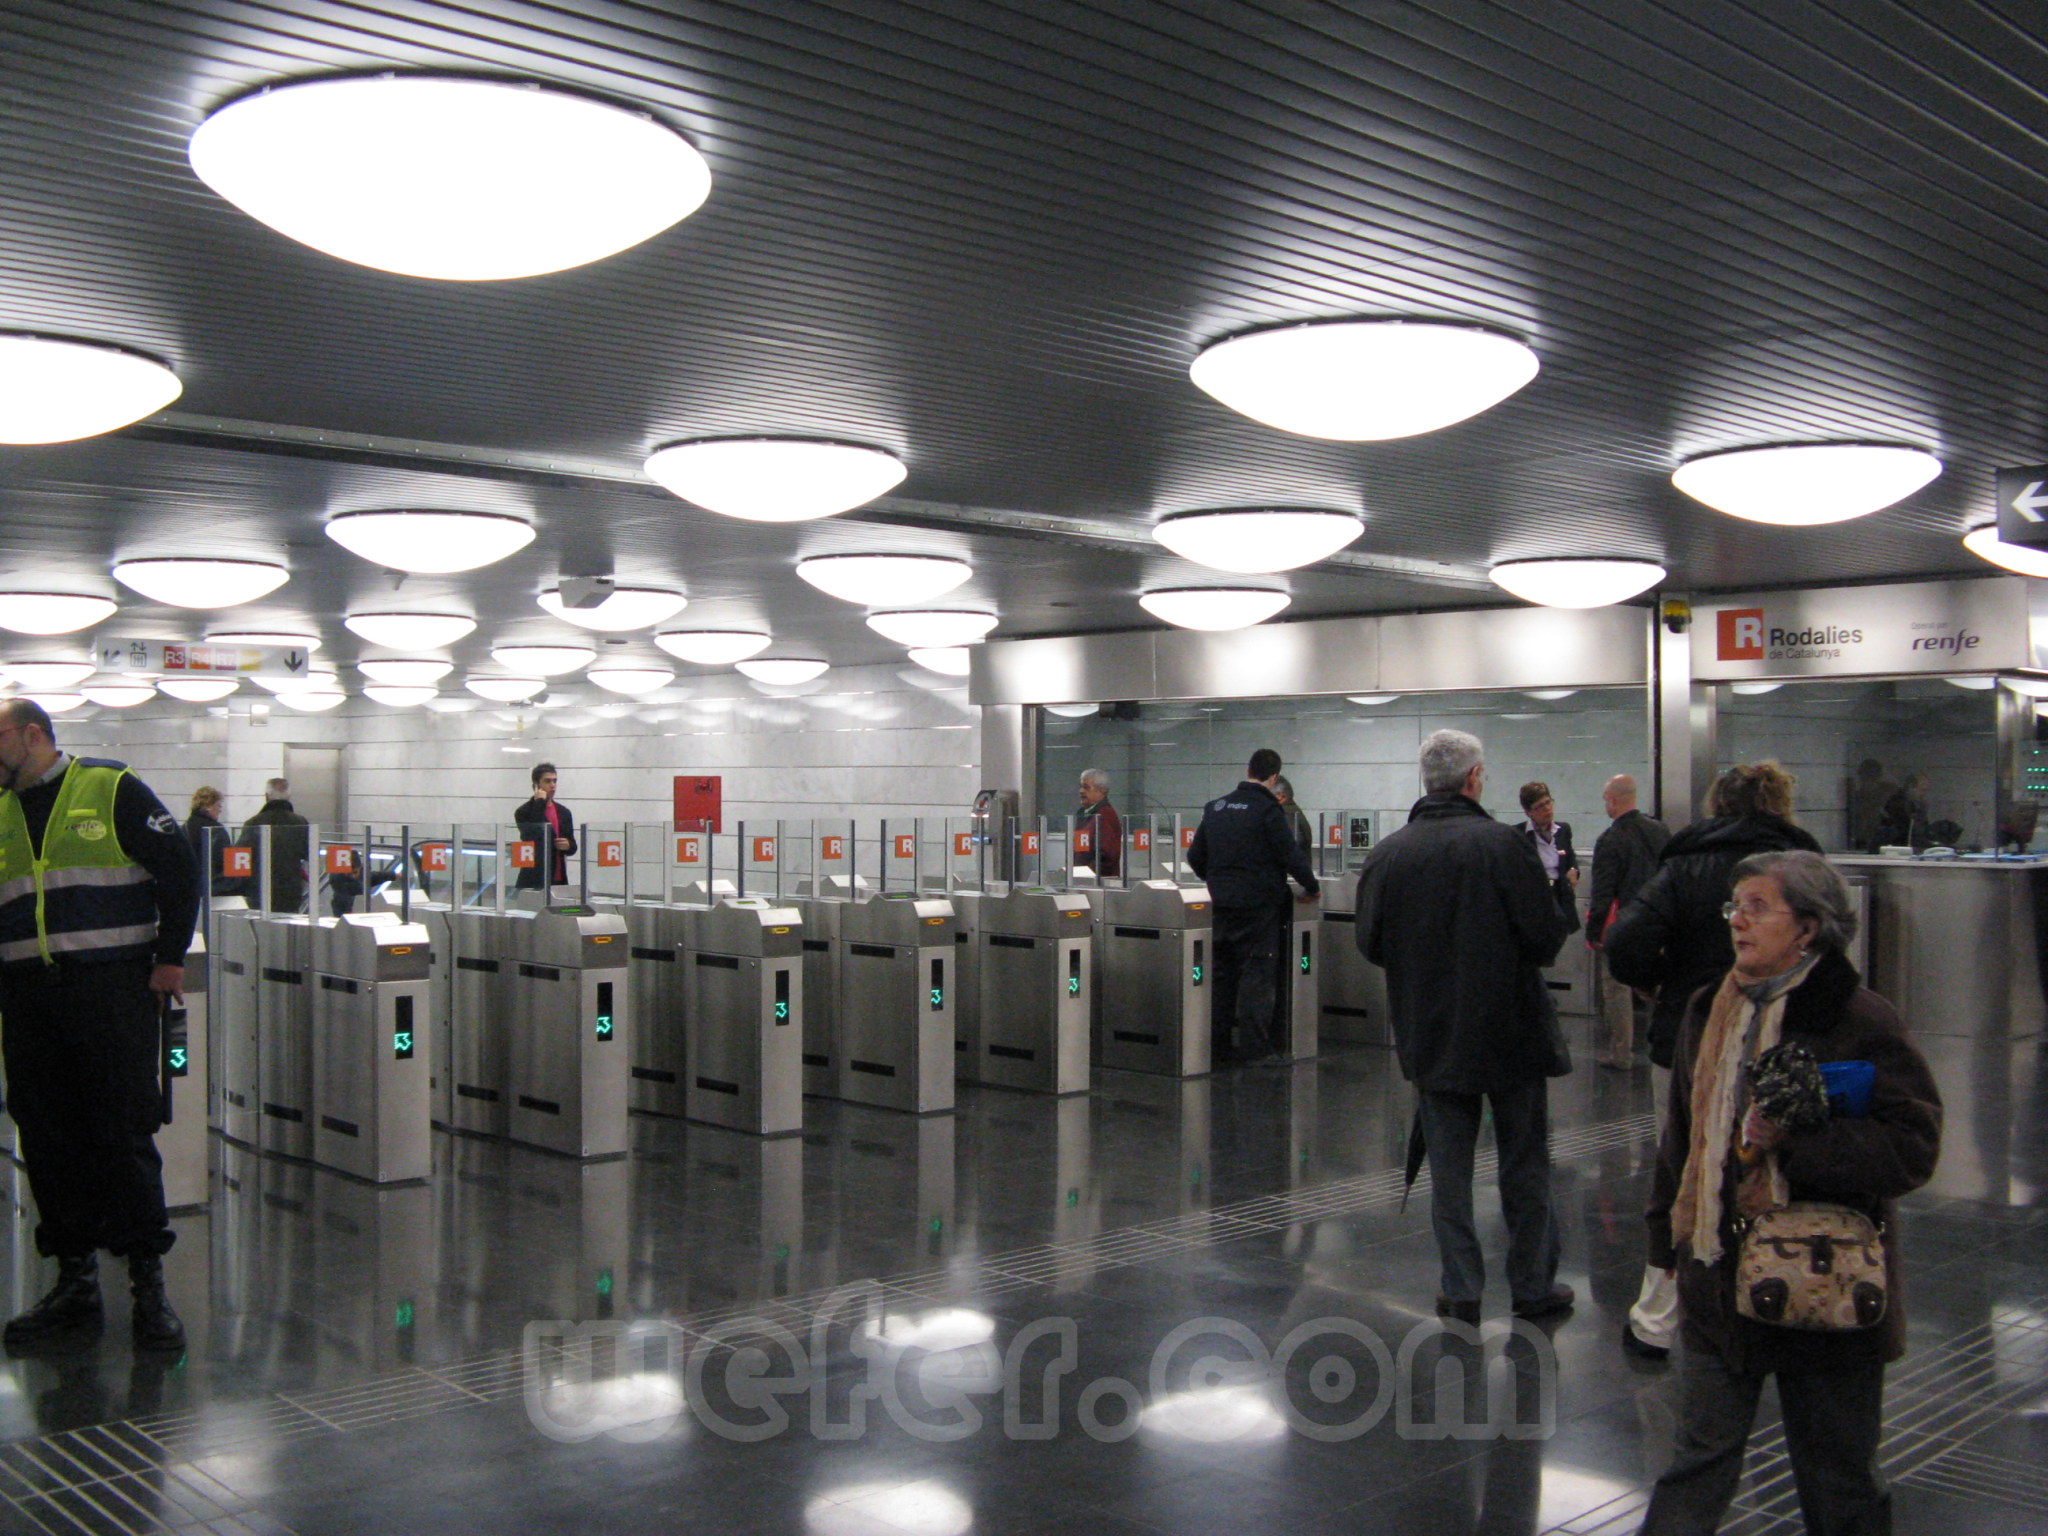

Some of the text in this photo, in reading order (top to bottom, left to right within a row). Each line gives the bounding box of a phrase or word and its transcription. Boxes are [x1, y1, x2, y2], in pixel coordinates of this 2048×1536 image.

[1735, 617, 1762, 648] R
[1770, 626, 1863, 646] Rodalies
[1912, 629, 1980, 656] renfe
[165, 651, 185, 664] R3
[217, 653, 235, 666] R7
[1769, 647, 1840, 660] de Catalunya
[1080, 834, 1090, 847] R
[1140, 833, 1150, 846] R
[1186, 831, 1196, 843] R
[1334, 828, 1342, 839] R
[685, 842, 698, 857] R
[761, 841, 774, 856] R
[830, 840, 842, 854] R
[902, 839, 913, 853] R
[961, 837, 972, 850] R
[1028, 835, 1038, 849] R
[234, 852, 251, 869] R
[336, 850, 351, 866] R
[432, 848, 447, 865] R
[520, 846, 534, 861] R
[607, 845, 620, 861] R
